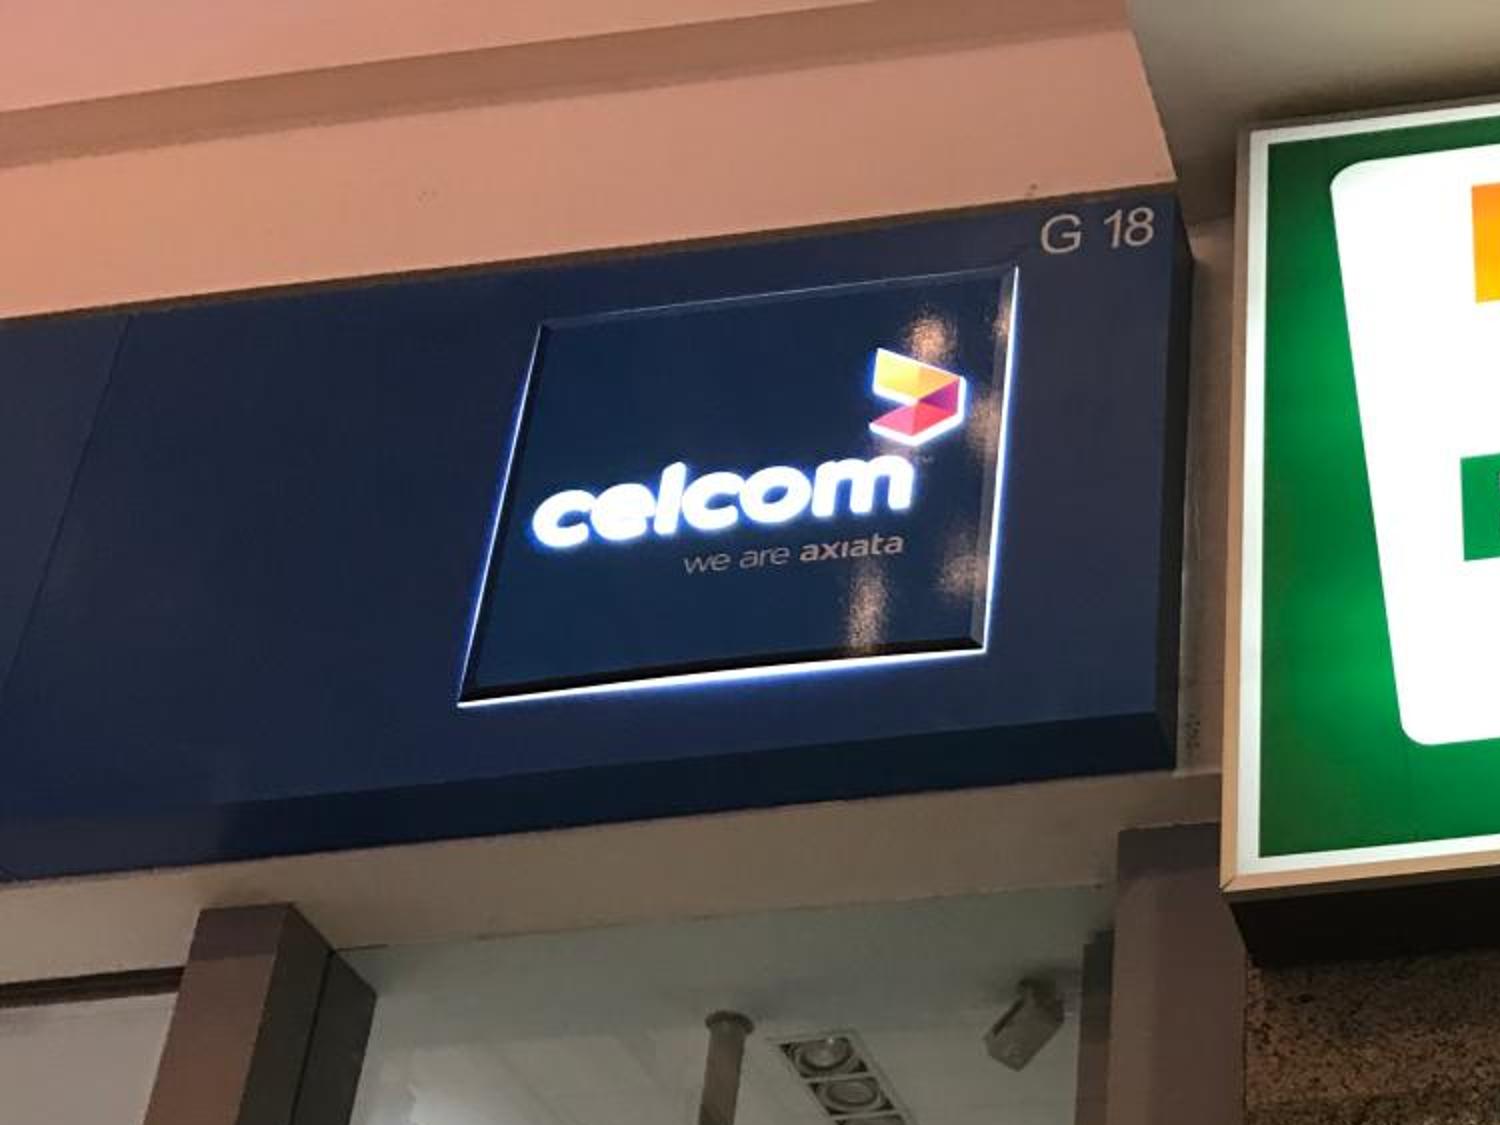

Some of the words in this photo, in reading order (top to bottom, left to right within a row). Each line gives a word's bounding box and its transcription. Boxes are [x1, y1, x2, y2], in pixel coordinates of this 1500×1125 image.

[1040, 213, 1082, 254] G
[1103, 206, 1154, 249] 18
[531, 454, 916, 549] celcom
[683, 552, 731, 575] we
[739, 546, 790, 570] are
[799, 532, 905, 562] axiata
